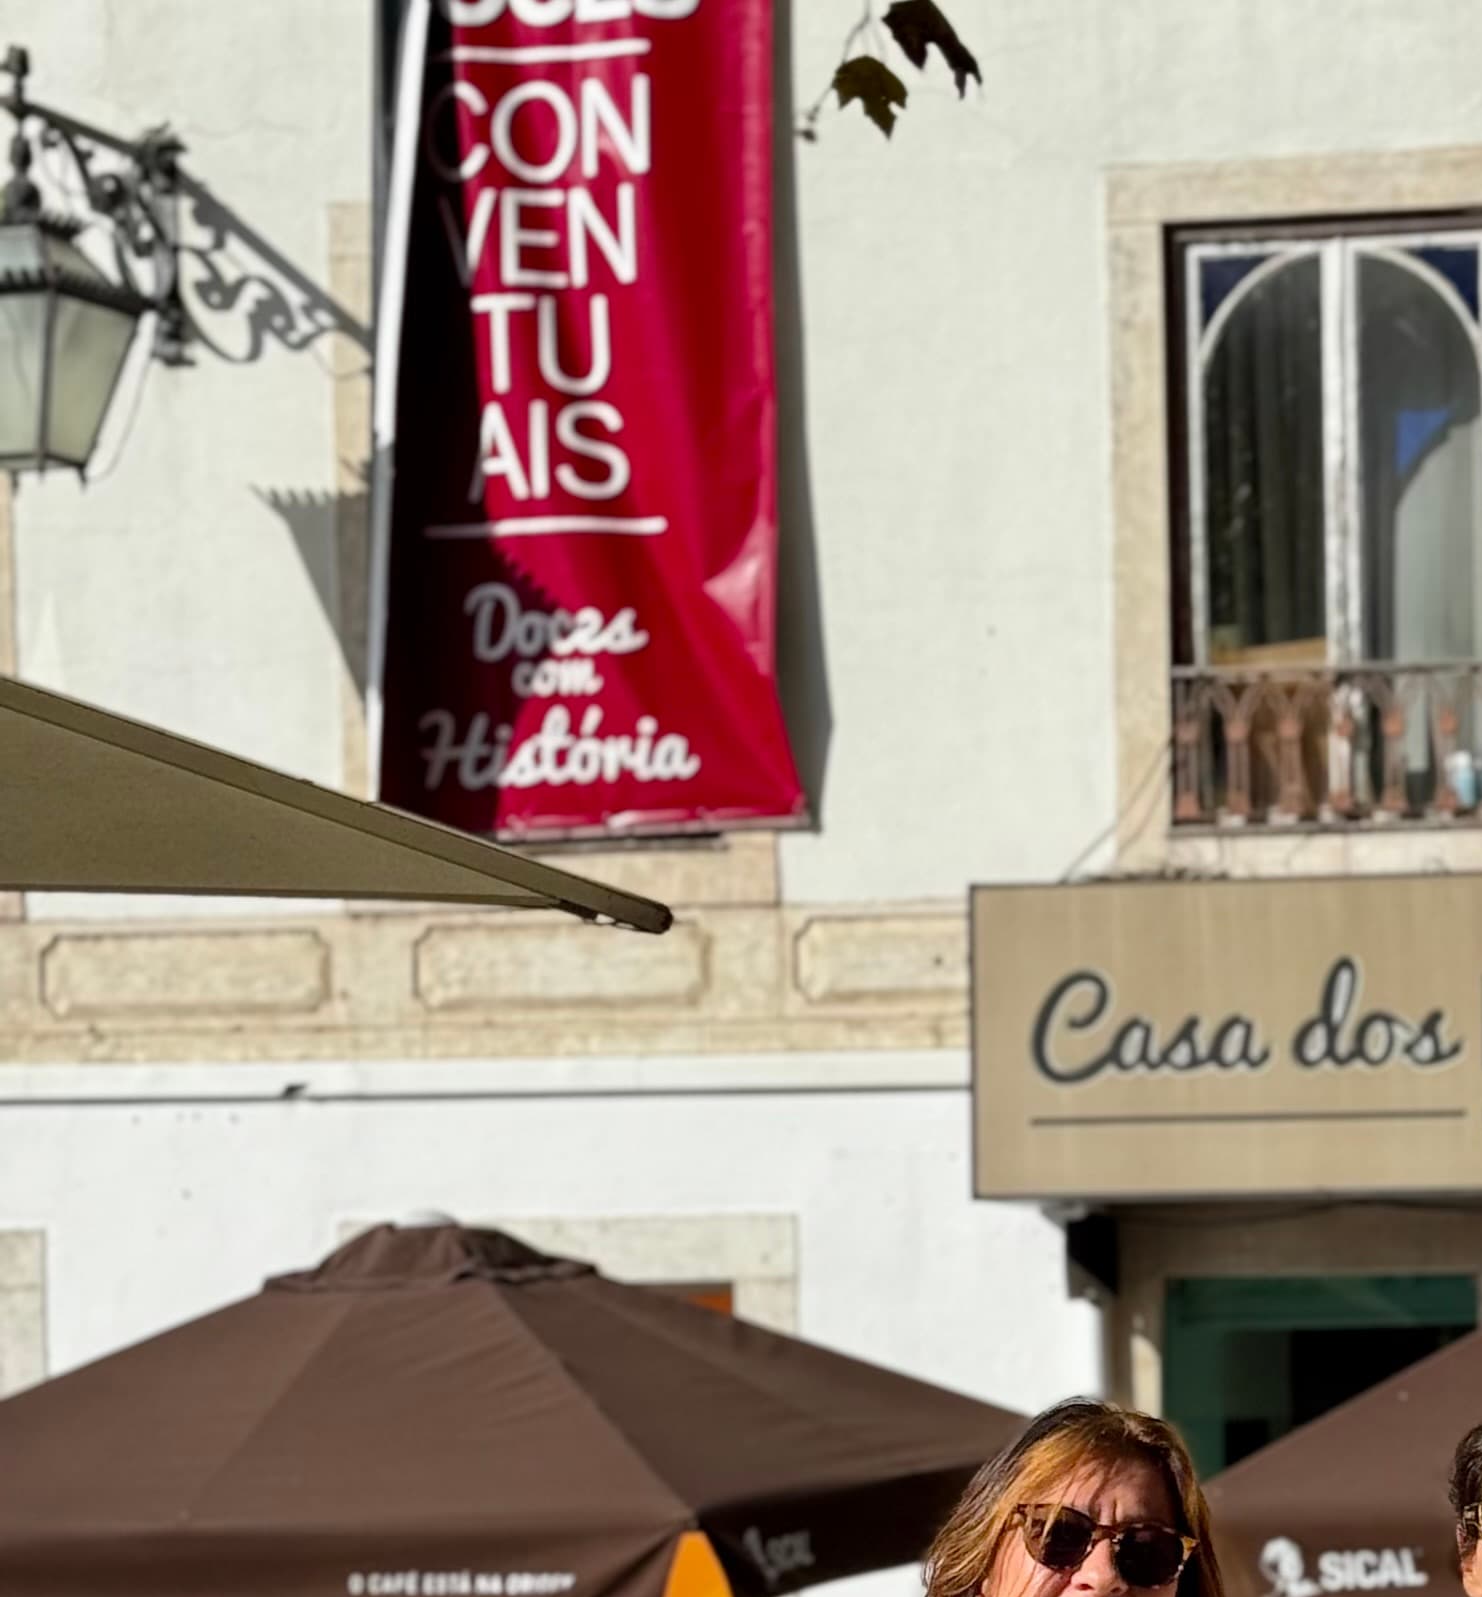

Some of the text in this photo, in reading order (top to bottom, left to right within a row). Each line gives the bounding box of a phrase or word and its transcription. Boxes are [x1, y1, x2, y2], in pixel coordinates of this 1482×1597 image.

[427, 73, 650, 183] CON
[441, 182, 637, 288] VEN
[470, 294, 612, 395] TU
[469, 399, 631, 501] AIS
[464, 582, 650, 662] Doces
[512, 658, 605, 698] com
[419, 704, 701, 790] História
[1031, 968, 1270, 1084] Casa
[1292, 956, 1463, 1067] dos
[1317, 1547, 1430, 1592] SICAL
